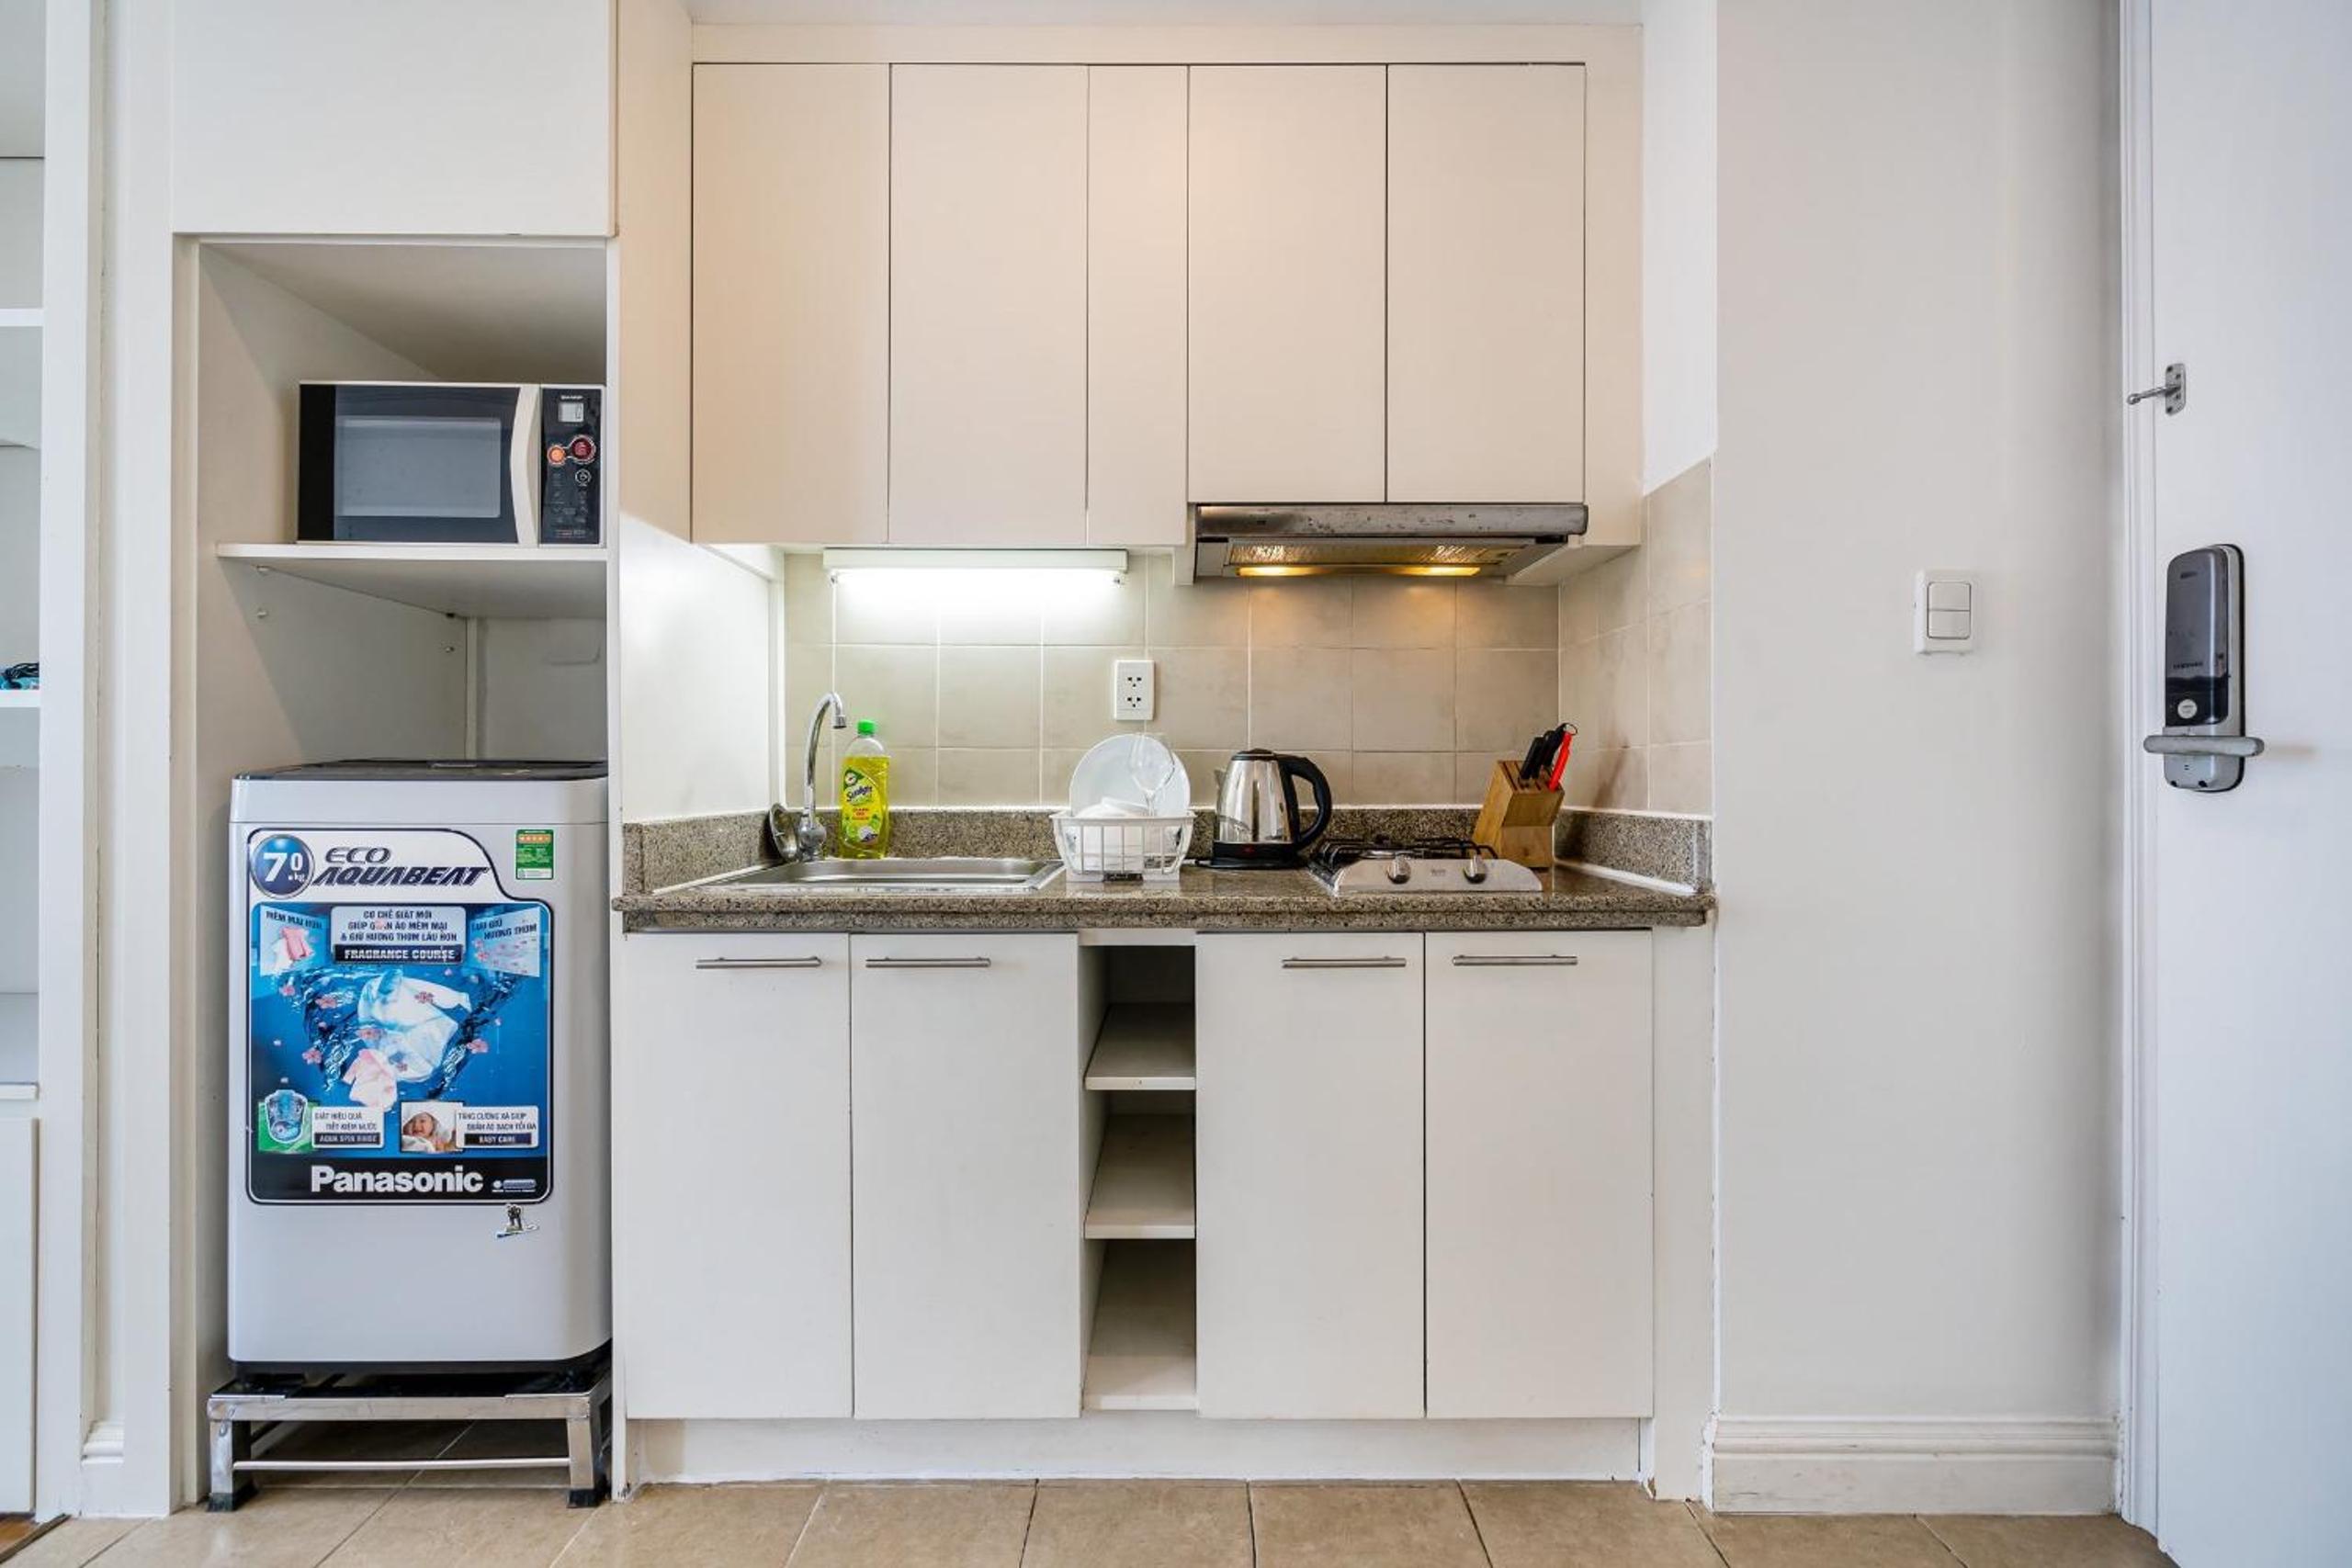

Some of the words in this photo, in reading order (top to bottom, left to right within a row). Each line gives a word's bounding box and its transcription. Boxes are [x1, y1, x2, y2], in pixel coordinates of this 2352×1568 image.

[325, 847, 391, 864] ECO
[311, 866, 491, 886] AQUABEAT
[345, 949, 409, 959] FRAGRANCE
[412, 949, 456, 959] COURSE
[311, 1165, 483, 1192] Panasonic
